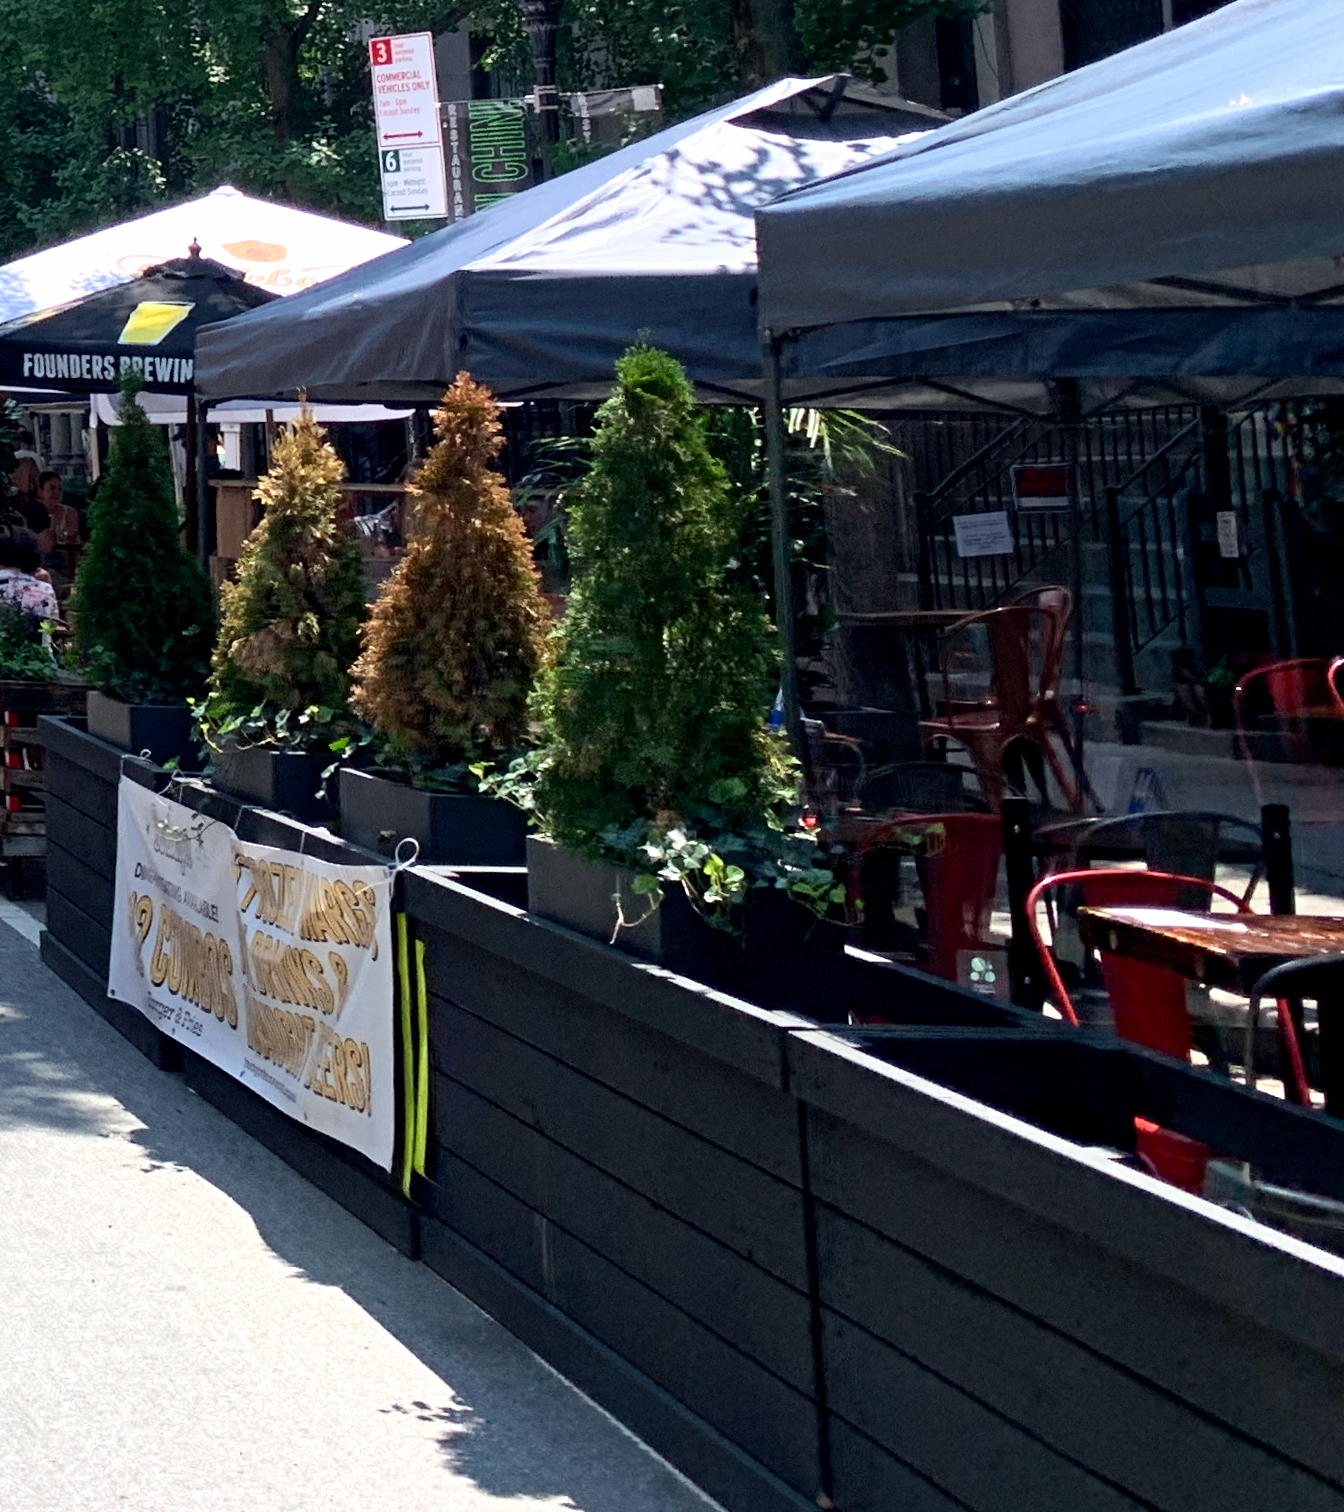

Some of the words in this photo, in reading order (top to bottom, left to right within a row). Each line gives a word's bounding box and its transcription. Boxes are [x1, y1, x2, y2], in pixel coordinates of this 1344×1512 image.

[376, 42, 387, 63] 3
[376, 70, 421, 83] COMMERCIAL
[377, 84, 411, 95] VEHICLES
[412, 81, 430, 92] ONLY
[385, 151, 397, 172] 6
[23, 353, 115, 380] FOUNDERS
[150, 903, 238, 1030] COMBOS
